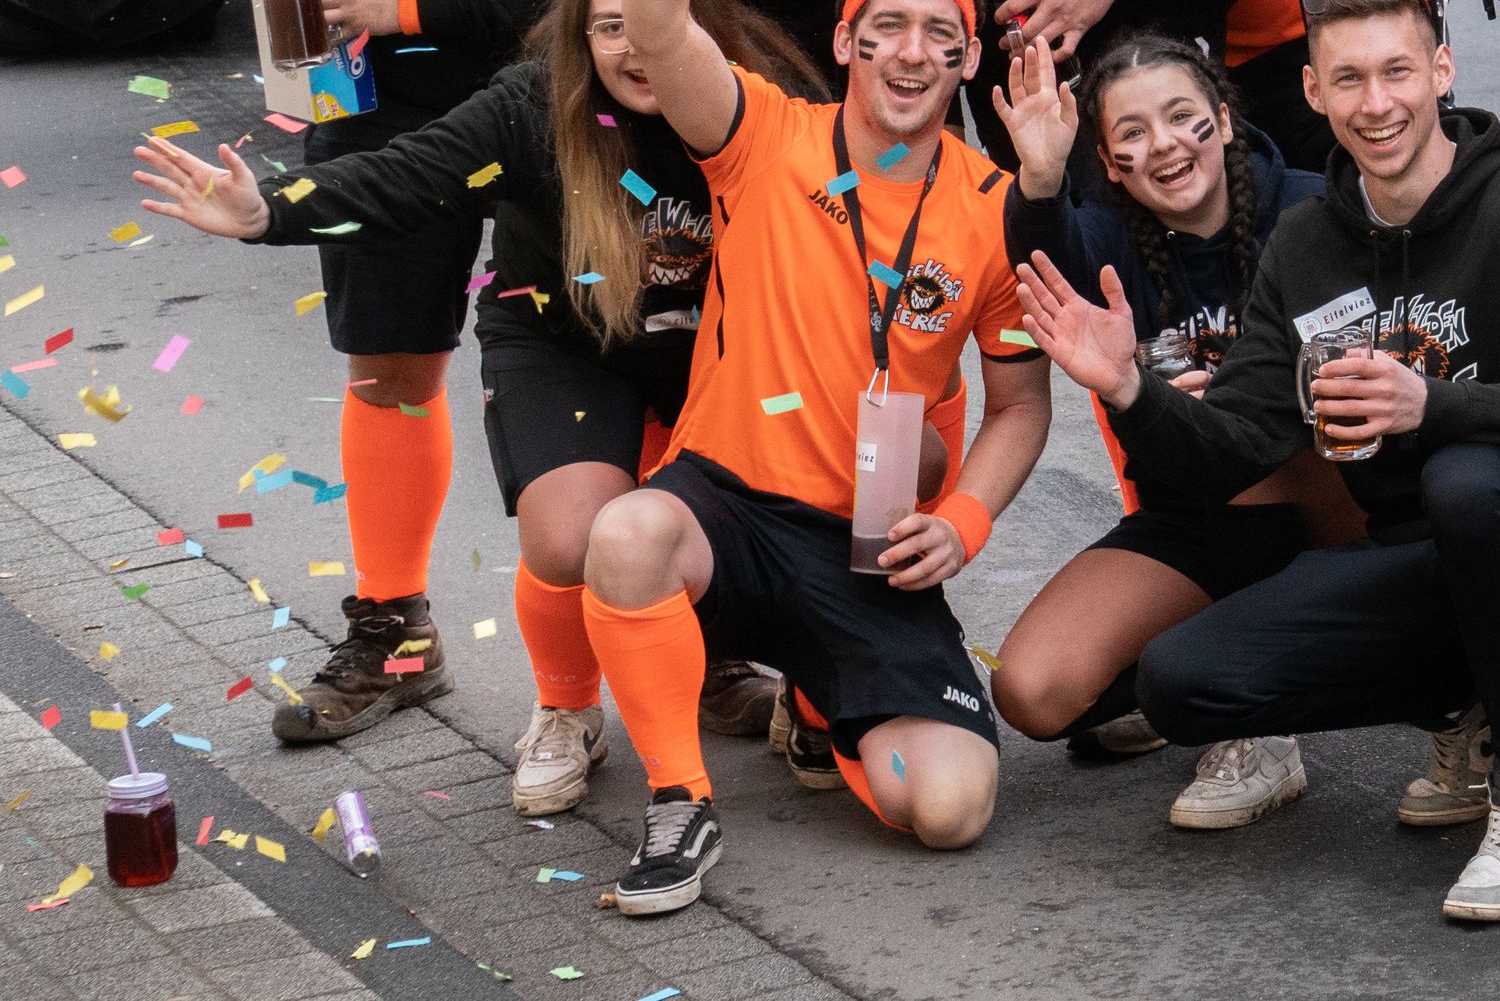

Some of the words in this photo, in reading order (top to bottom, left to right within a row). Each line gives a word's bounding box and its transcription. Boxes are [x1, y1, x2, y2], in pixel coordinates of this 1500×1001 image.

[808, 188, 849, 225] JAKO
[1323, 296, 1372, 325] Eifelviez
[942, 685, 980, 712] JAKO
